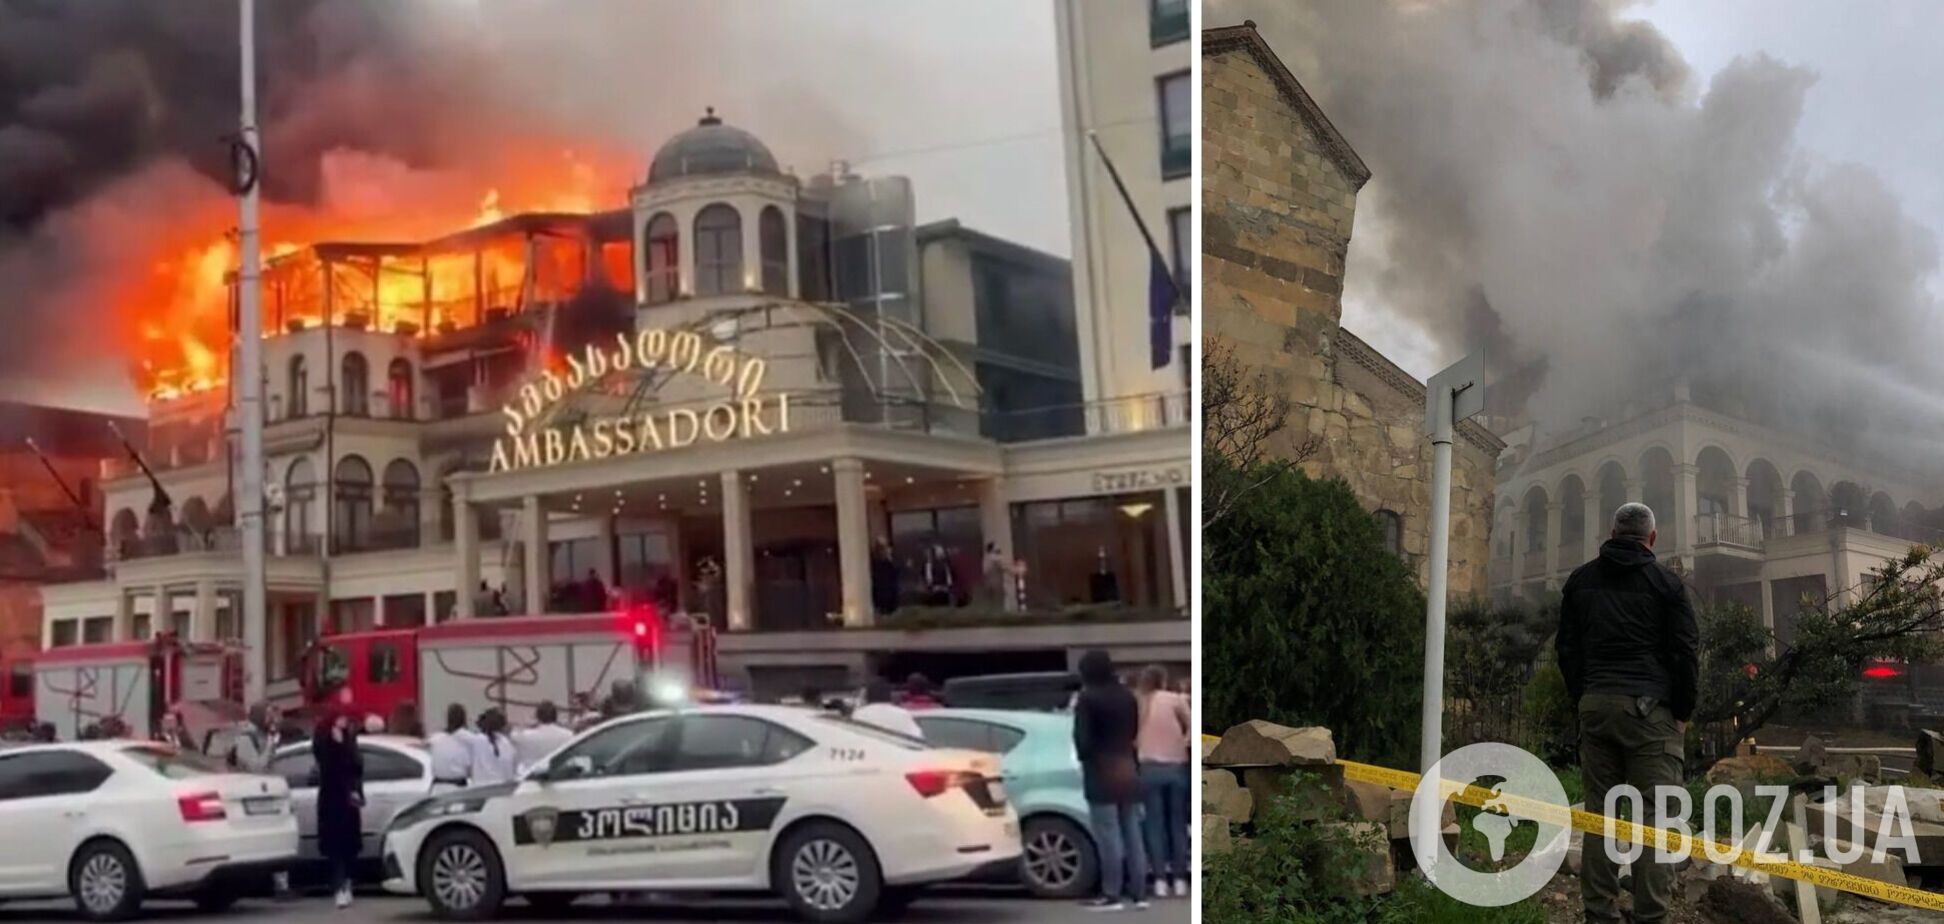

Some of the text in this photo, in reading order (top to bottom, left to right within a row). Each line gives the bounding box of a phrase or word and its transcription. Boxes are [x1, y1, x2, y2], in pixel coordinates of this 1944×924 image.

[489, 393, 789, 474] AMBASSADORI
[830, 748, 865, 761] 7124
[577, 801, 738, 839] პოლიცია
